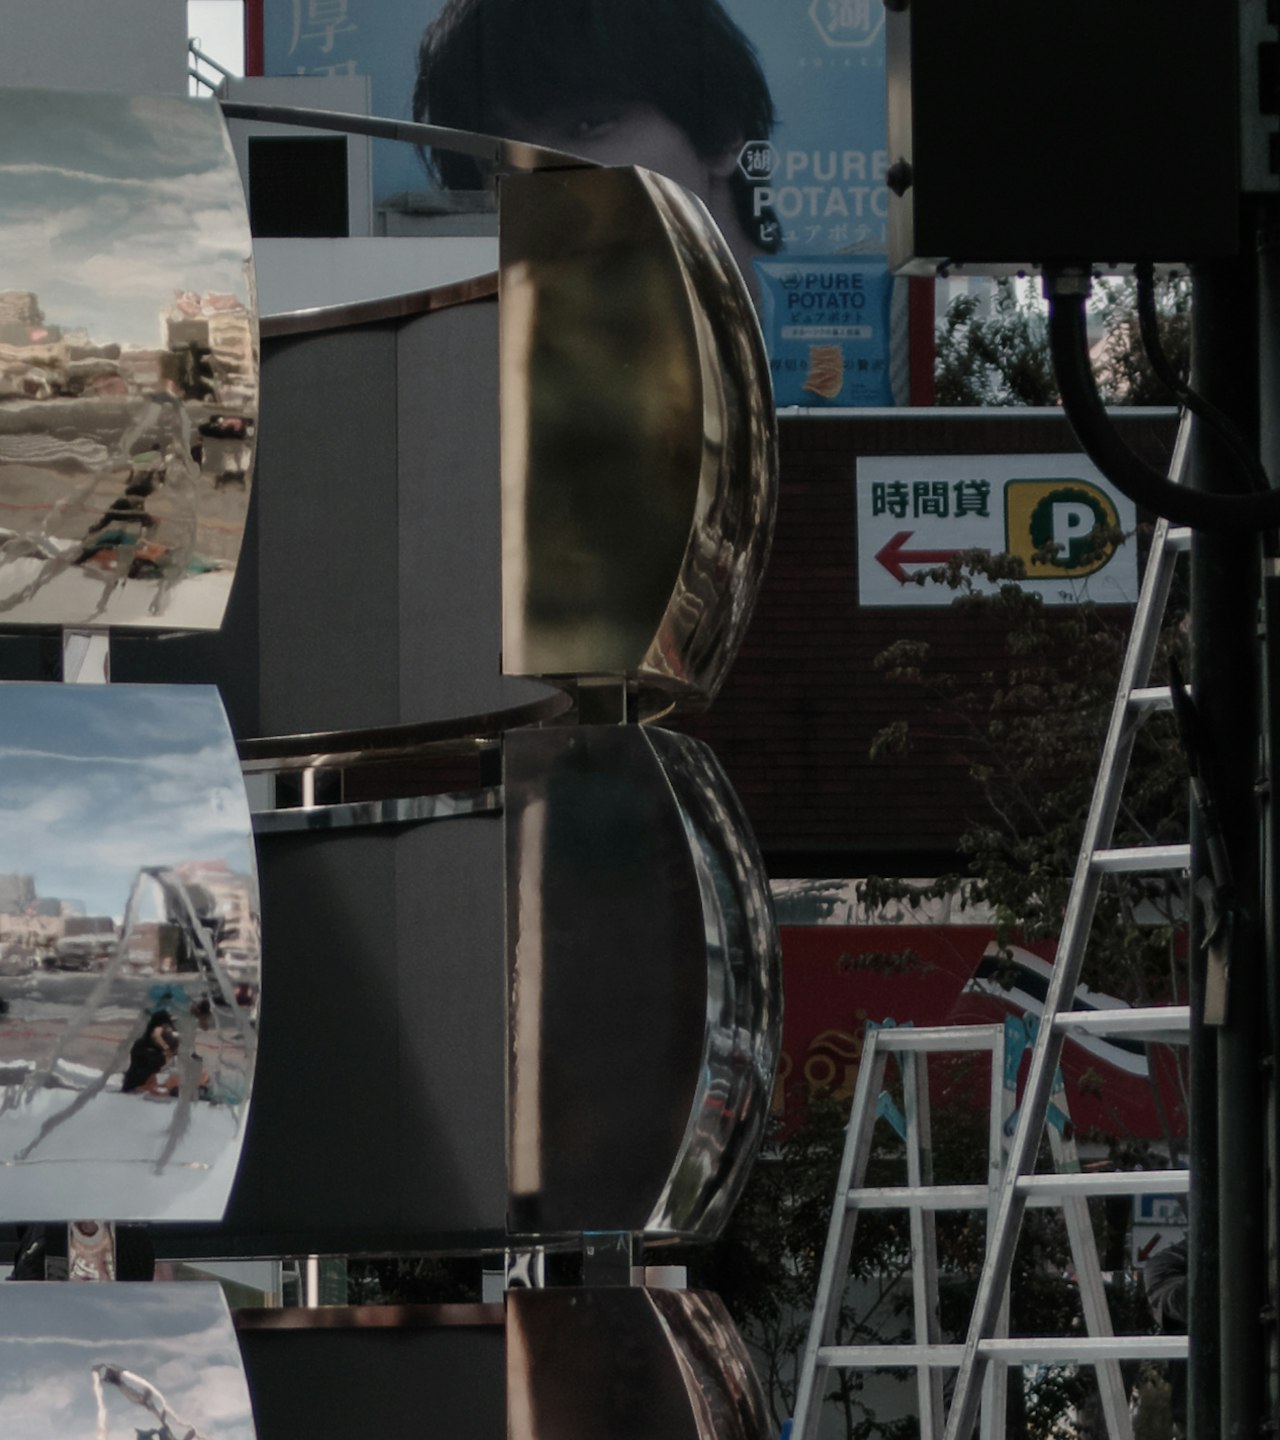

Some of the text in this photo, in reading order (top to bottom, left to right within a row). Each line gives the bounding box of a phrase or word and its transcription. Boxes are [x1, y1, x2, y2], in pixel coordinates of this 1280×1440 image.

[288, 0, 358, 76] 厚
[787, 151, 887, 181] PURE
[805, 273, 865, 290] PURE
[787, 292, 866, 309] POTATO
[872, 480, 990, 518] 時間貸
[1050, 501, 1096, 559] P
